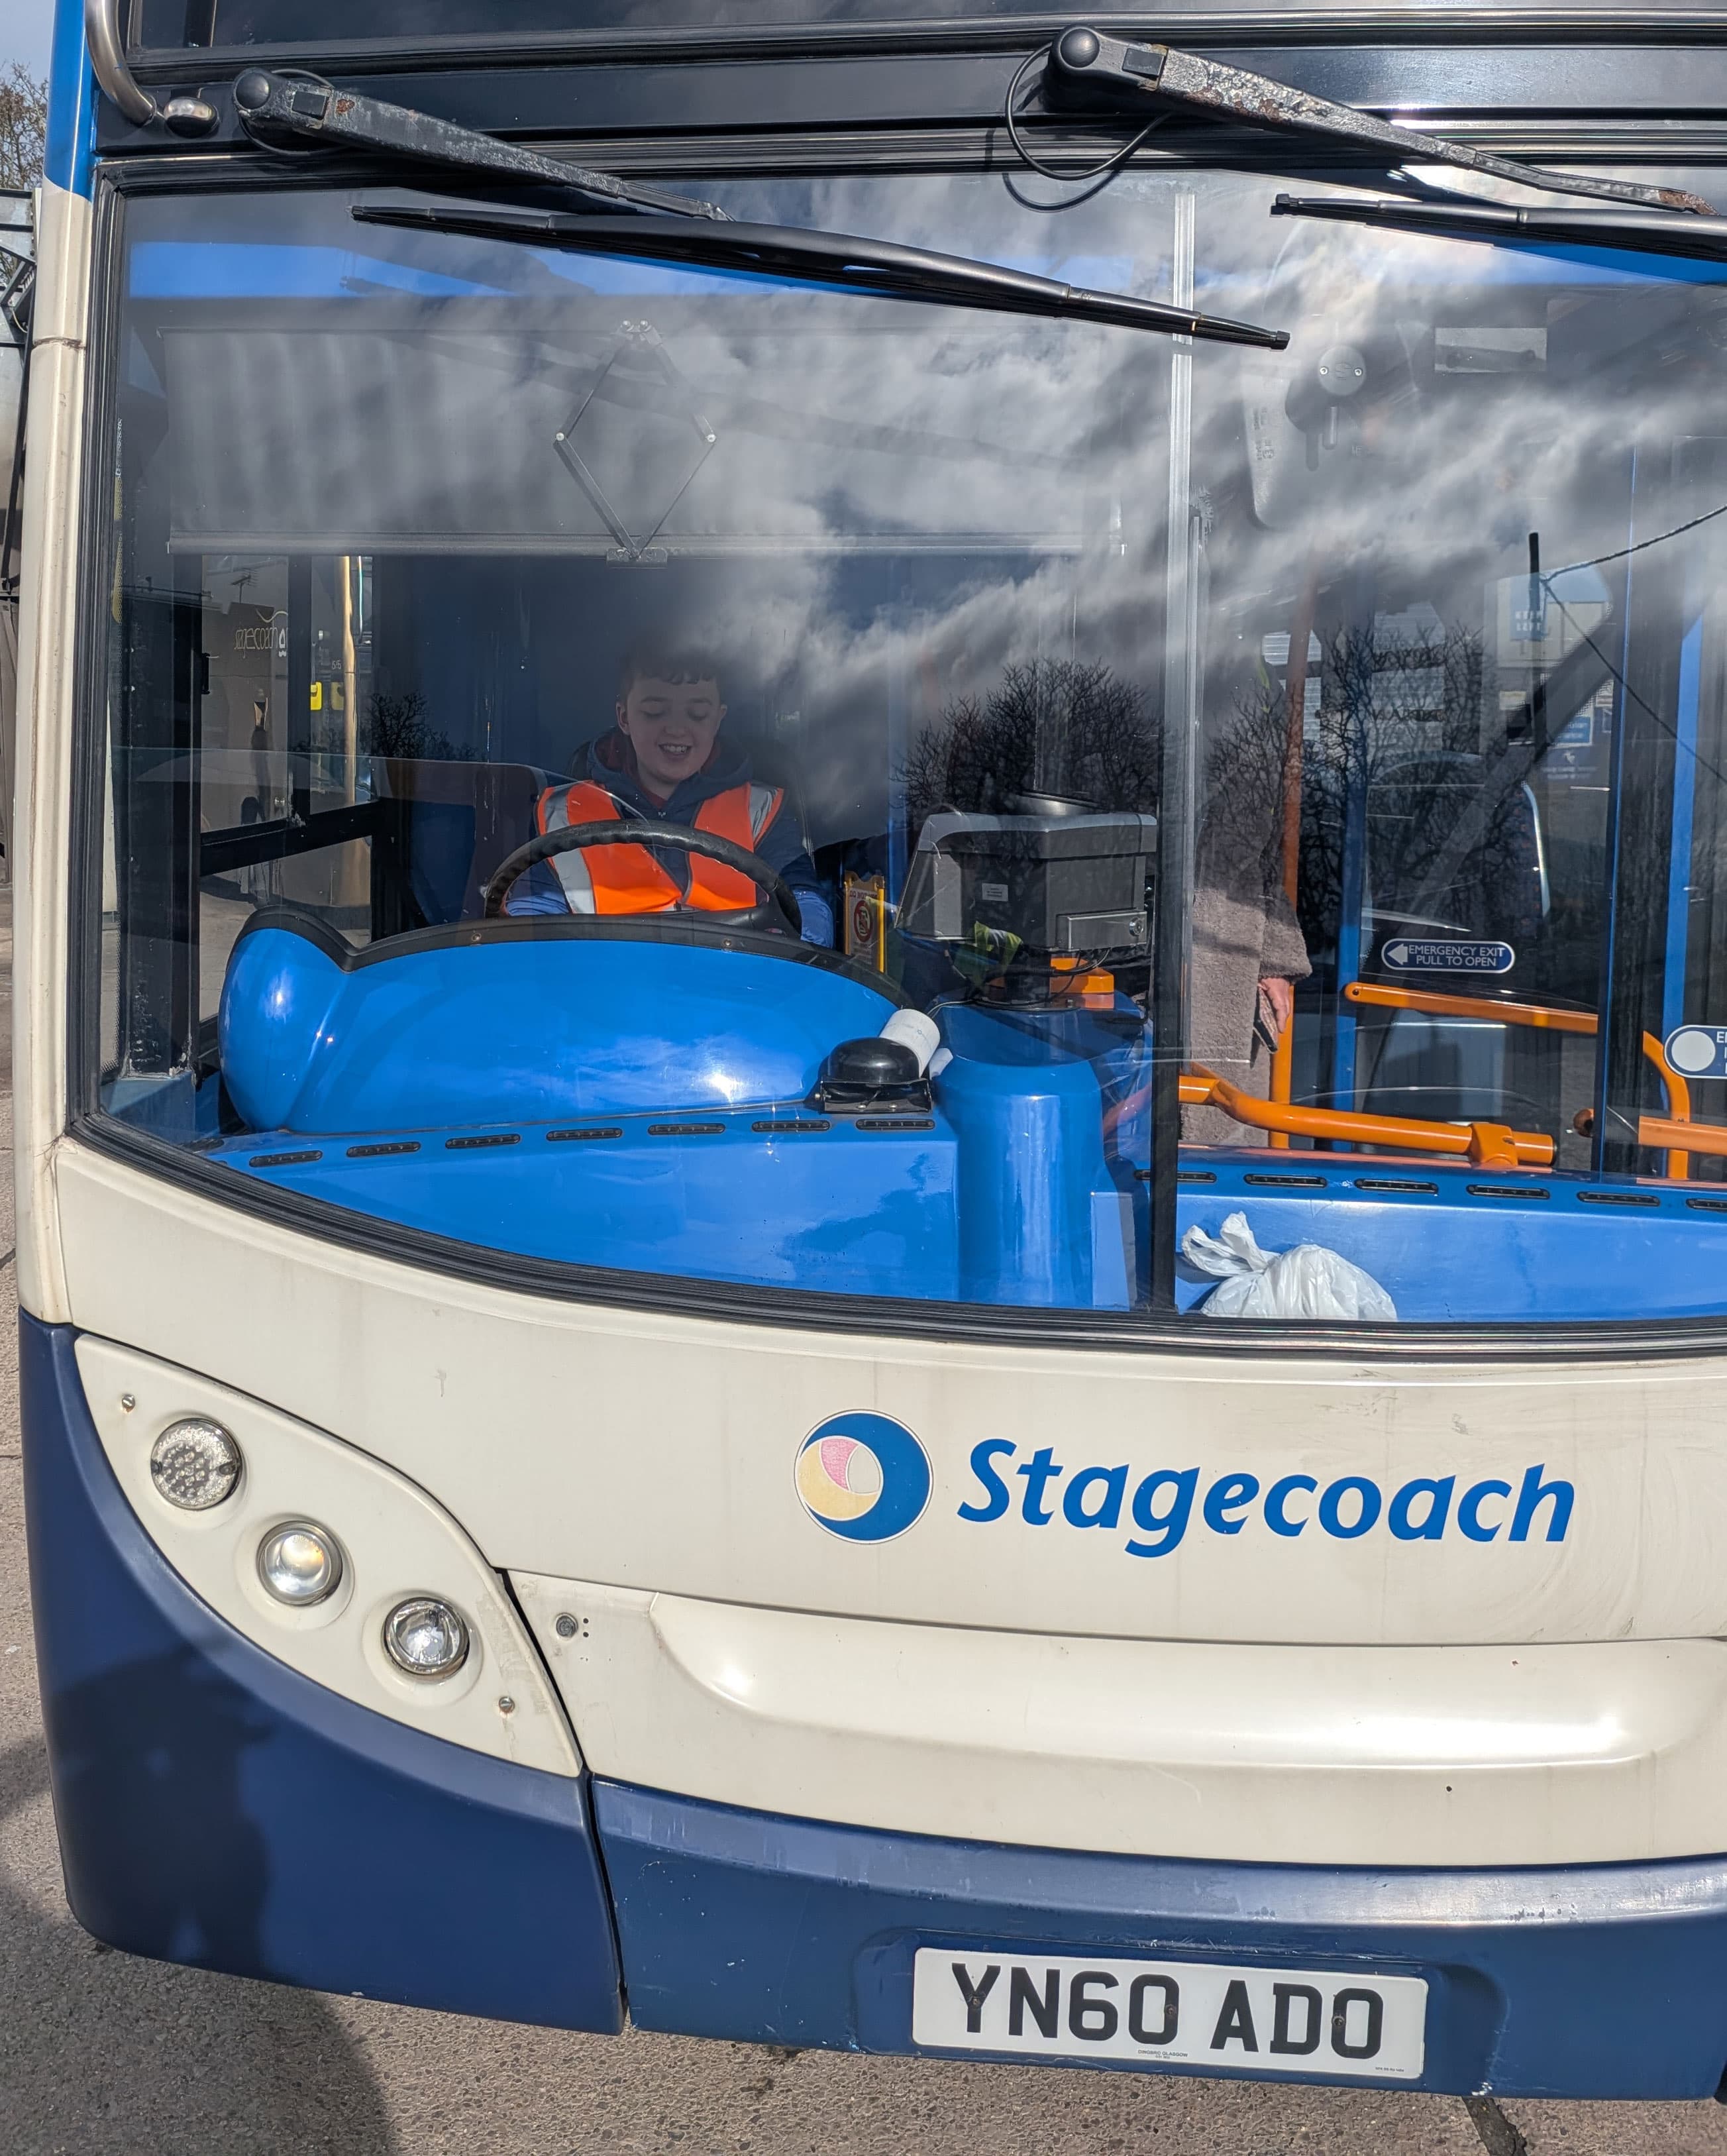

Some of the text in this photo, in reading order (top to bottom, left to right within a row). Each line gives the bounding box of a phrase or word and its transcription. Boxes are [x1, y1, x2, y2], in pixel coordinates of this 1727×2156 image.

[1408, 944, 1506, 957] EMERGENCY EXIT
[1416, 955, 1496, 967] PULL TO OPEN
[958, 1439, 1574, 1558] Stagecoach
[951, 1963, 1384, 2059] YN60 ADO
